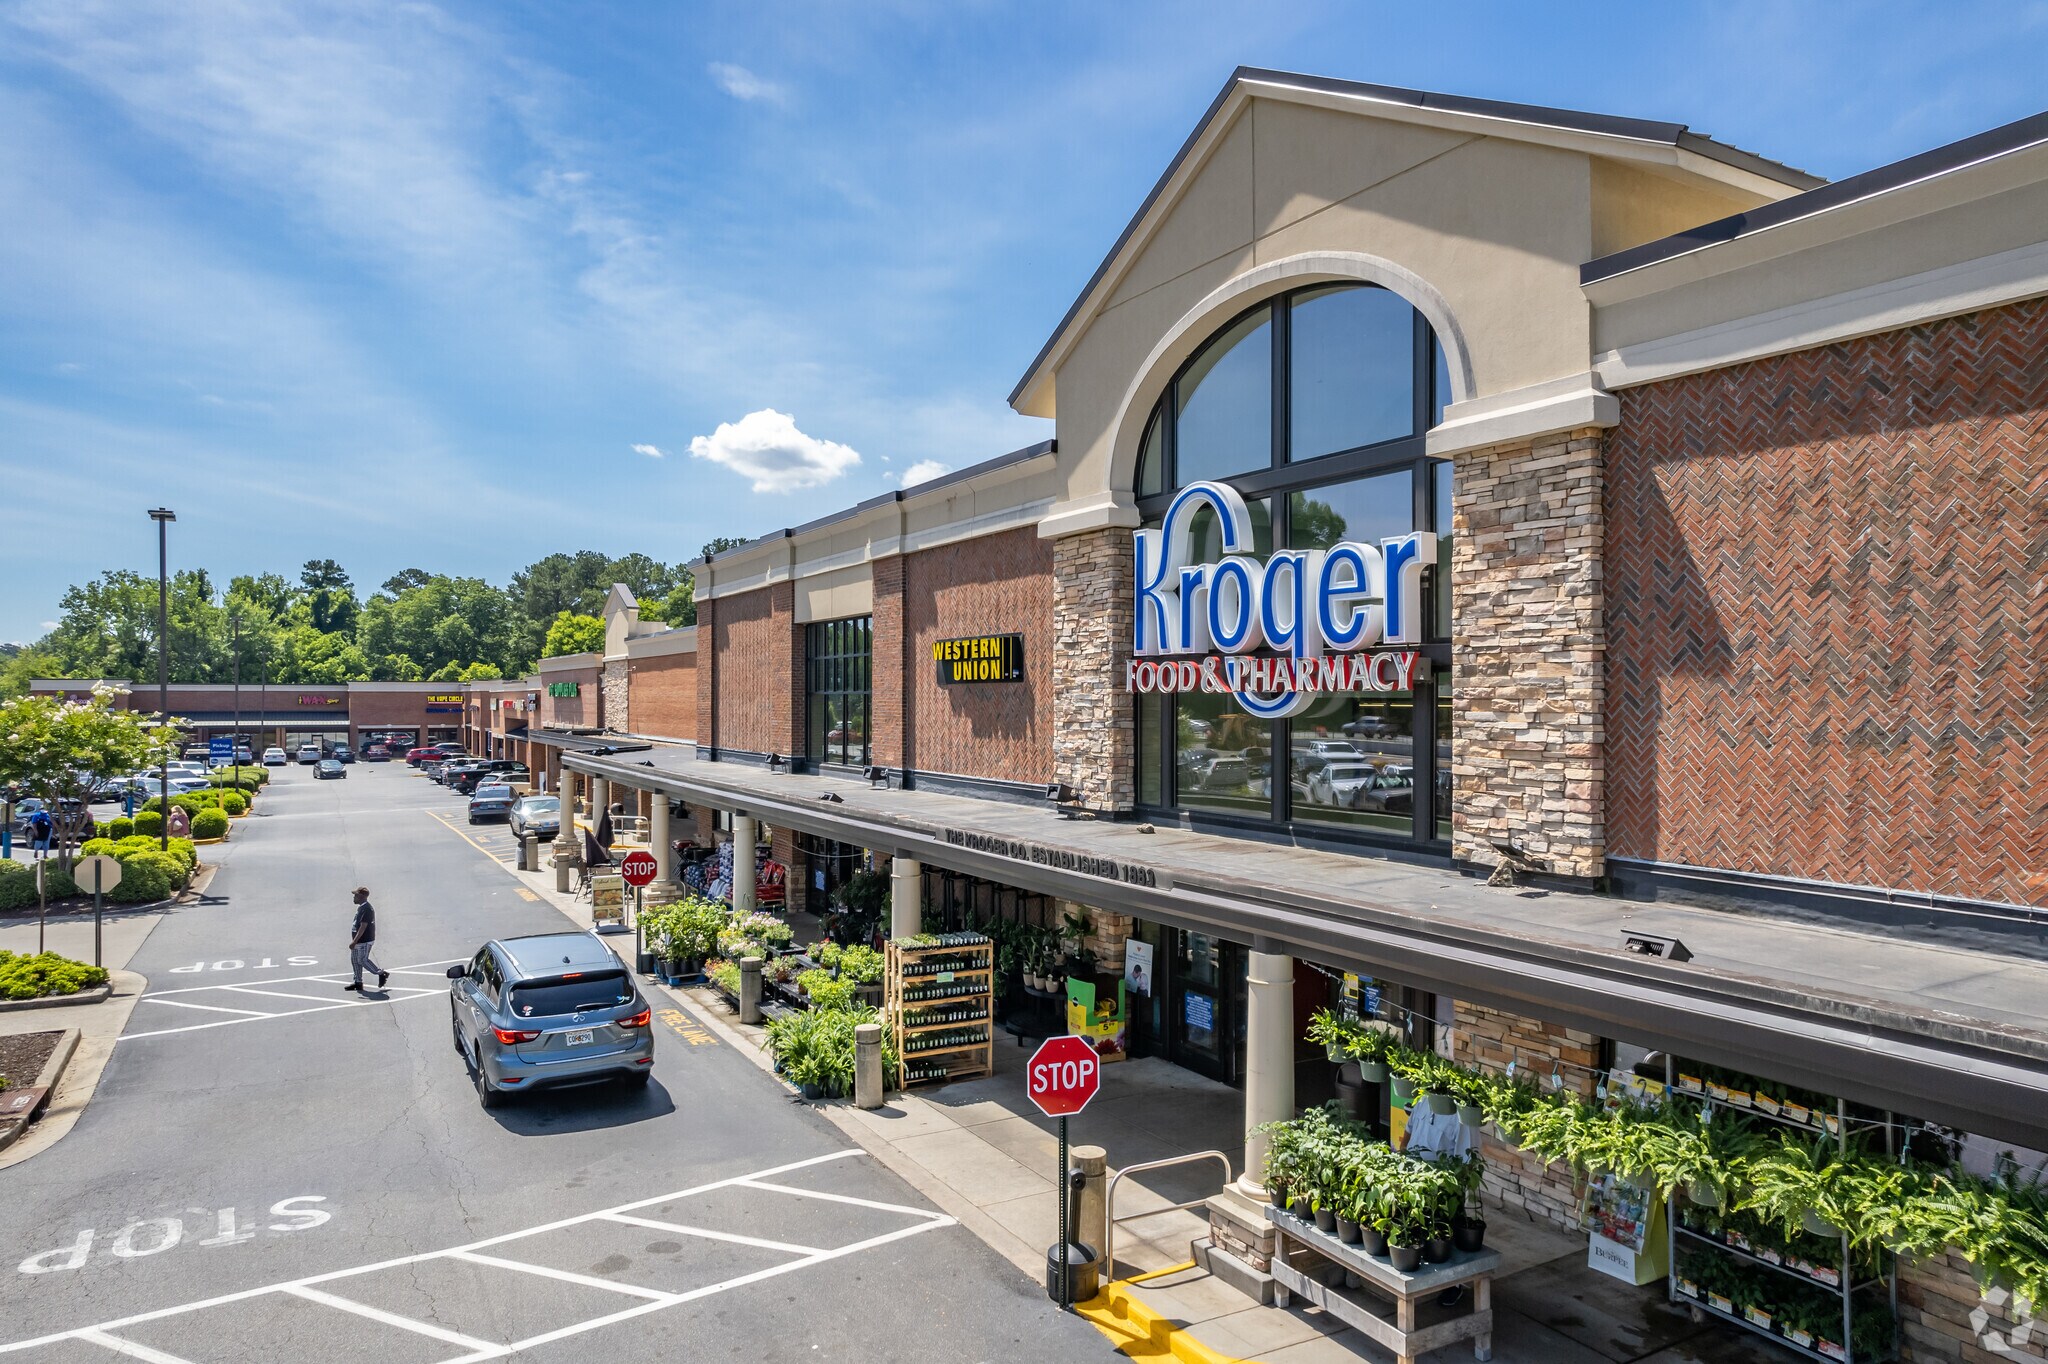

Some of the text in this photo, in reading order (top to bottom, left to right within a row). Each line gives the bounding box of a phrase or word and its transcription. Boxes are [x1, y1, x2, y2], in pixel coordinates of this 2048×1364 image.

[1133, 480, 1437, 718] Kroger
[932, 637, 1000, 660] WESTERN
[953, 659, 1000, 681] UNION
[1126, 660, 1200, 694] FOOD
[1229, 651, 1420, 693] PHARMACY
[624, 861, 656, 876] STOP
[945, 828, 1156, 888] THE KROGER CO. ESTABLISHED 1883
[168, 955, 320, 973] STOP
[656, 1008, 720, 1046] FIRE LANE
[1032, 1059, 1095, 1094] STOP
[17, 1195, 332, 1274] STOP
[1594, 1246, 1629, 1269] BURPEE
